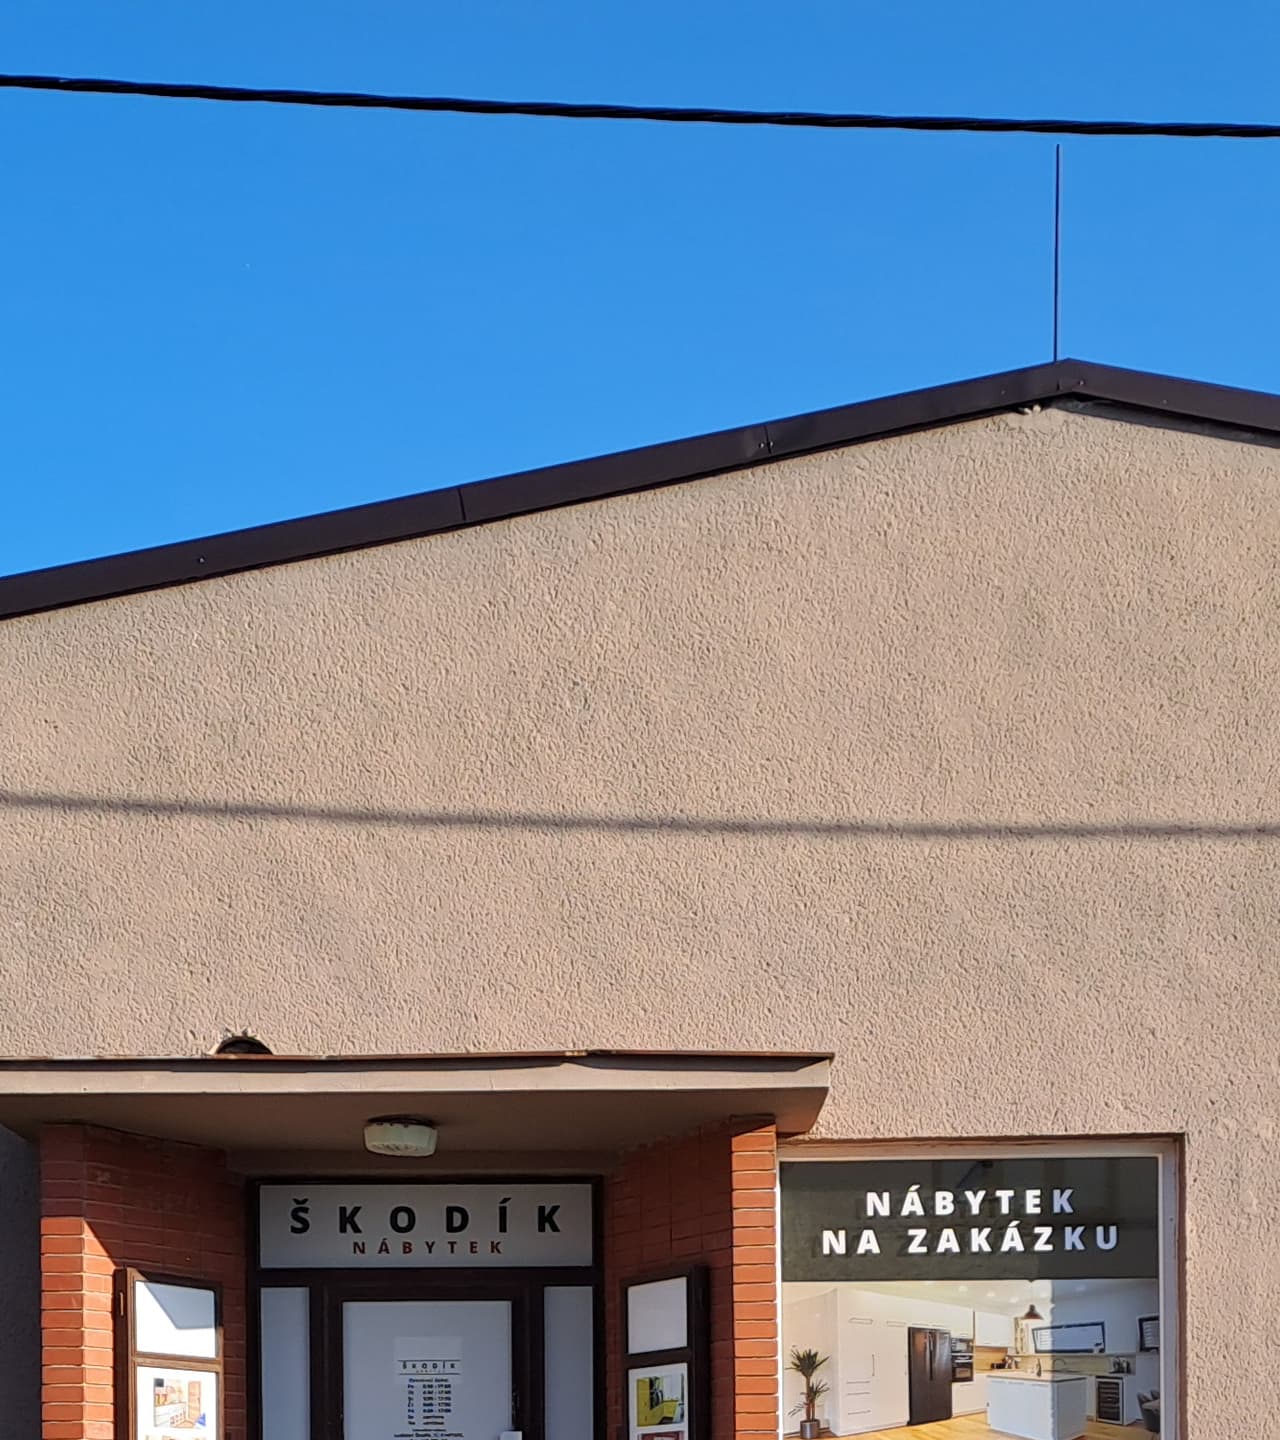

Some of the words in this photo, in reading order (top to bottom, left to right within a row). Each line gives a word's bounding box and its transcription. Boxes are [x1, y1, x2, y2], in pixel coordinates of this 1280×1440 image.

[289, 1198, 561, 1234] ŠKODÍK
[865, 1184, 1075, 1218] NÁBYTEK
[352, 1237, 503, 1255] NÁBYTEK
[821, 1226, 881, 1255] NA
[907, 1220, 1120, 1255] ZAKÁZKU
